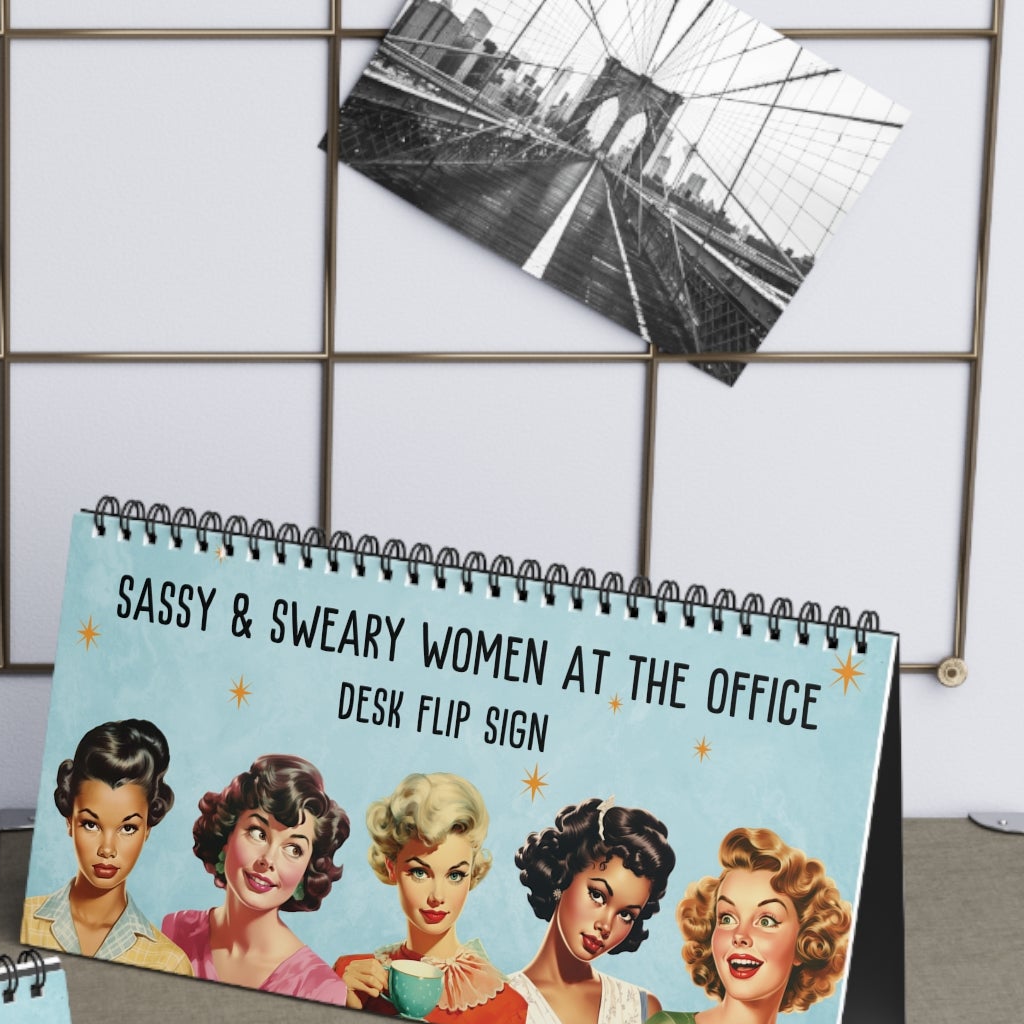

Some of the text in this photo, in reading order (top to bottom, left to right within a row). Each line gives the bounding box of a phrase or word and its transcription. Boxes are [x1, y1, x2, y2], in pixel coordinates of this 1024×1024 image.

[116, 574, 822, 730] SASSY & SWEARY WOMEN AT THE OFFICE
[338, 681, 549, 753] DESK FLIP SIGN
